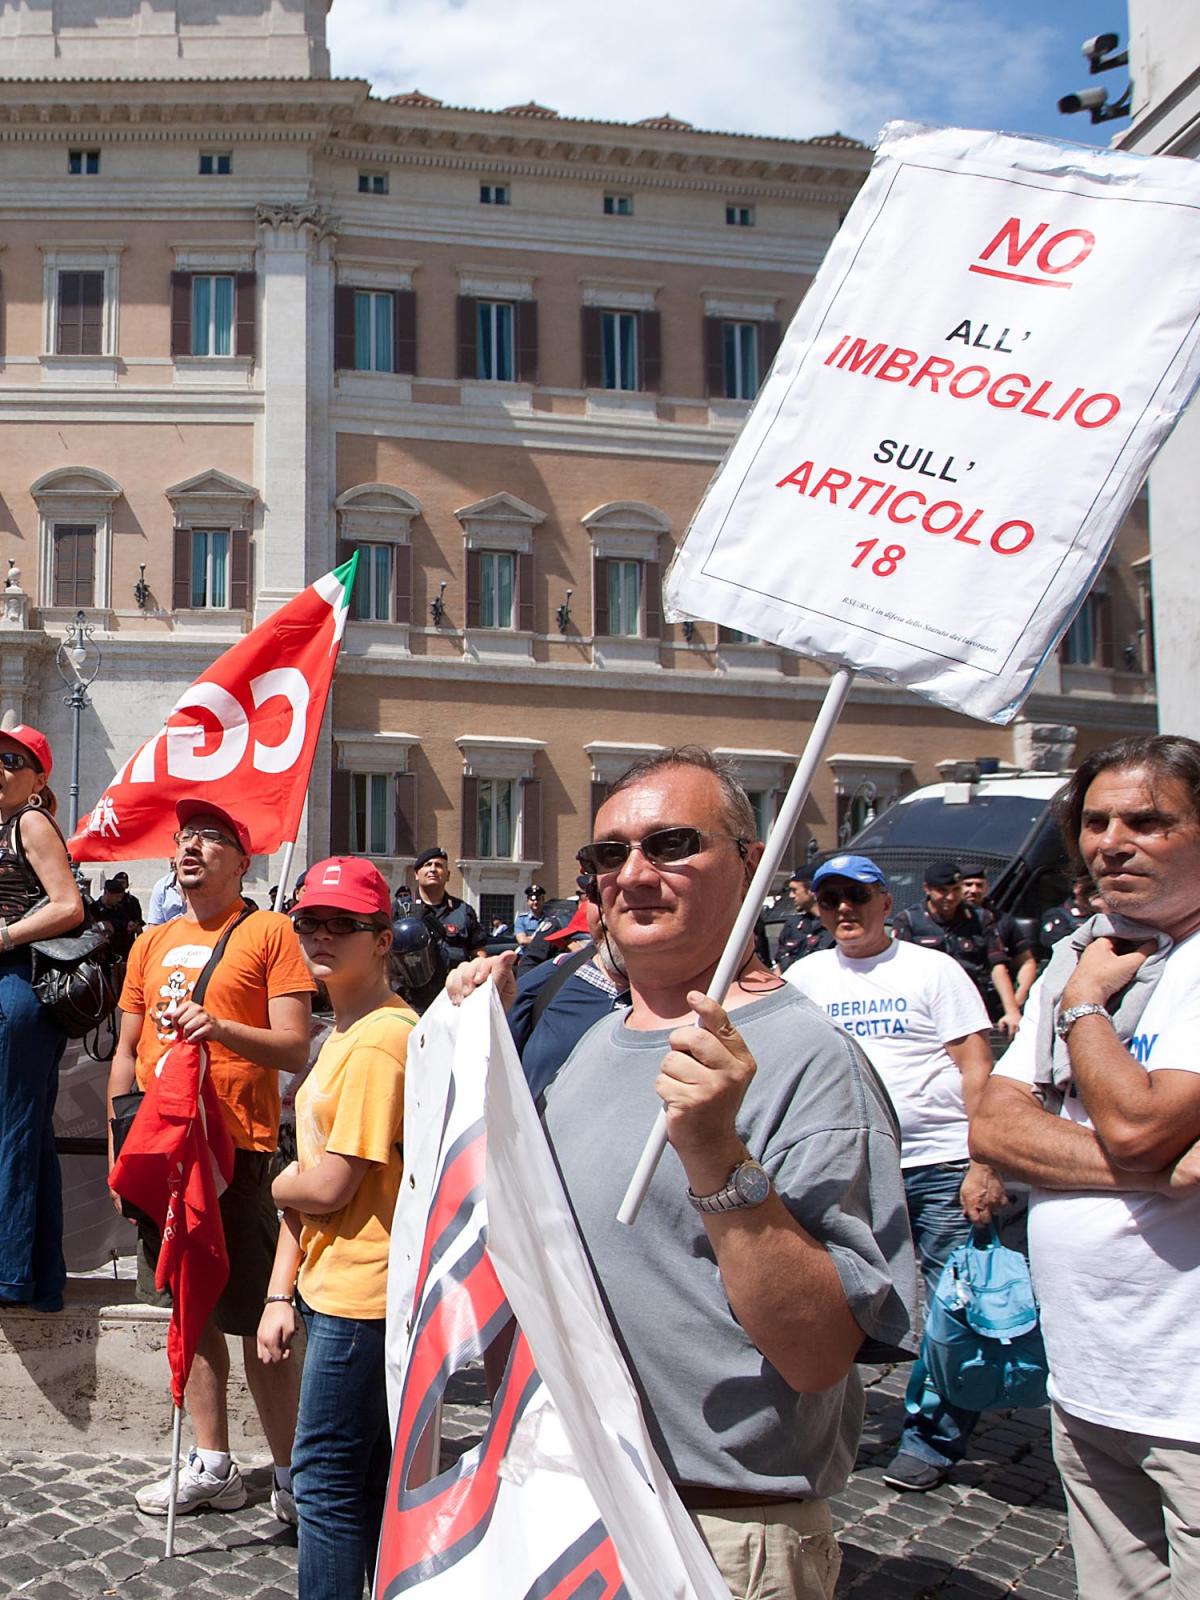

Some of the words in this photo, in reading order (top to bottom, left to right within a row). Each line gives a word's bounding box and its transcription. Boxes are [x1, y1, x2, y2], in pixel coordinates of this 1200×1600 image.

[978, 217, 1095, 275] NO
[945, 318, 1031, 354] ALL'
[824, 335, 1121, 429] IMBROGLIO
[873, 439, 976, 483] SULL'
[776, 460, 1035, 556] ARTICOLO
[851, 538, 907, 577] 18
[824, 997, 908, 1017] IBERIAMO
[843, 1018, 909, 1036] ECITTA'
